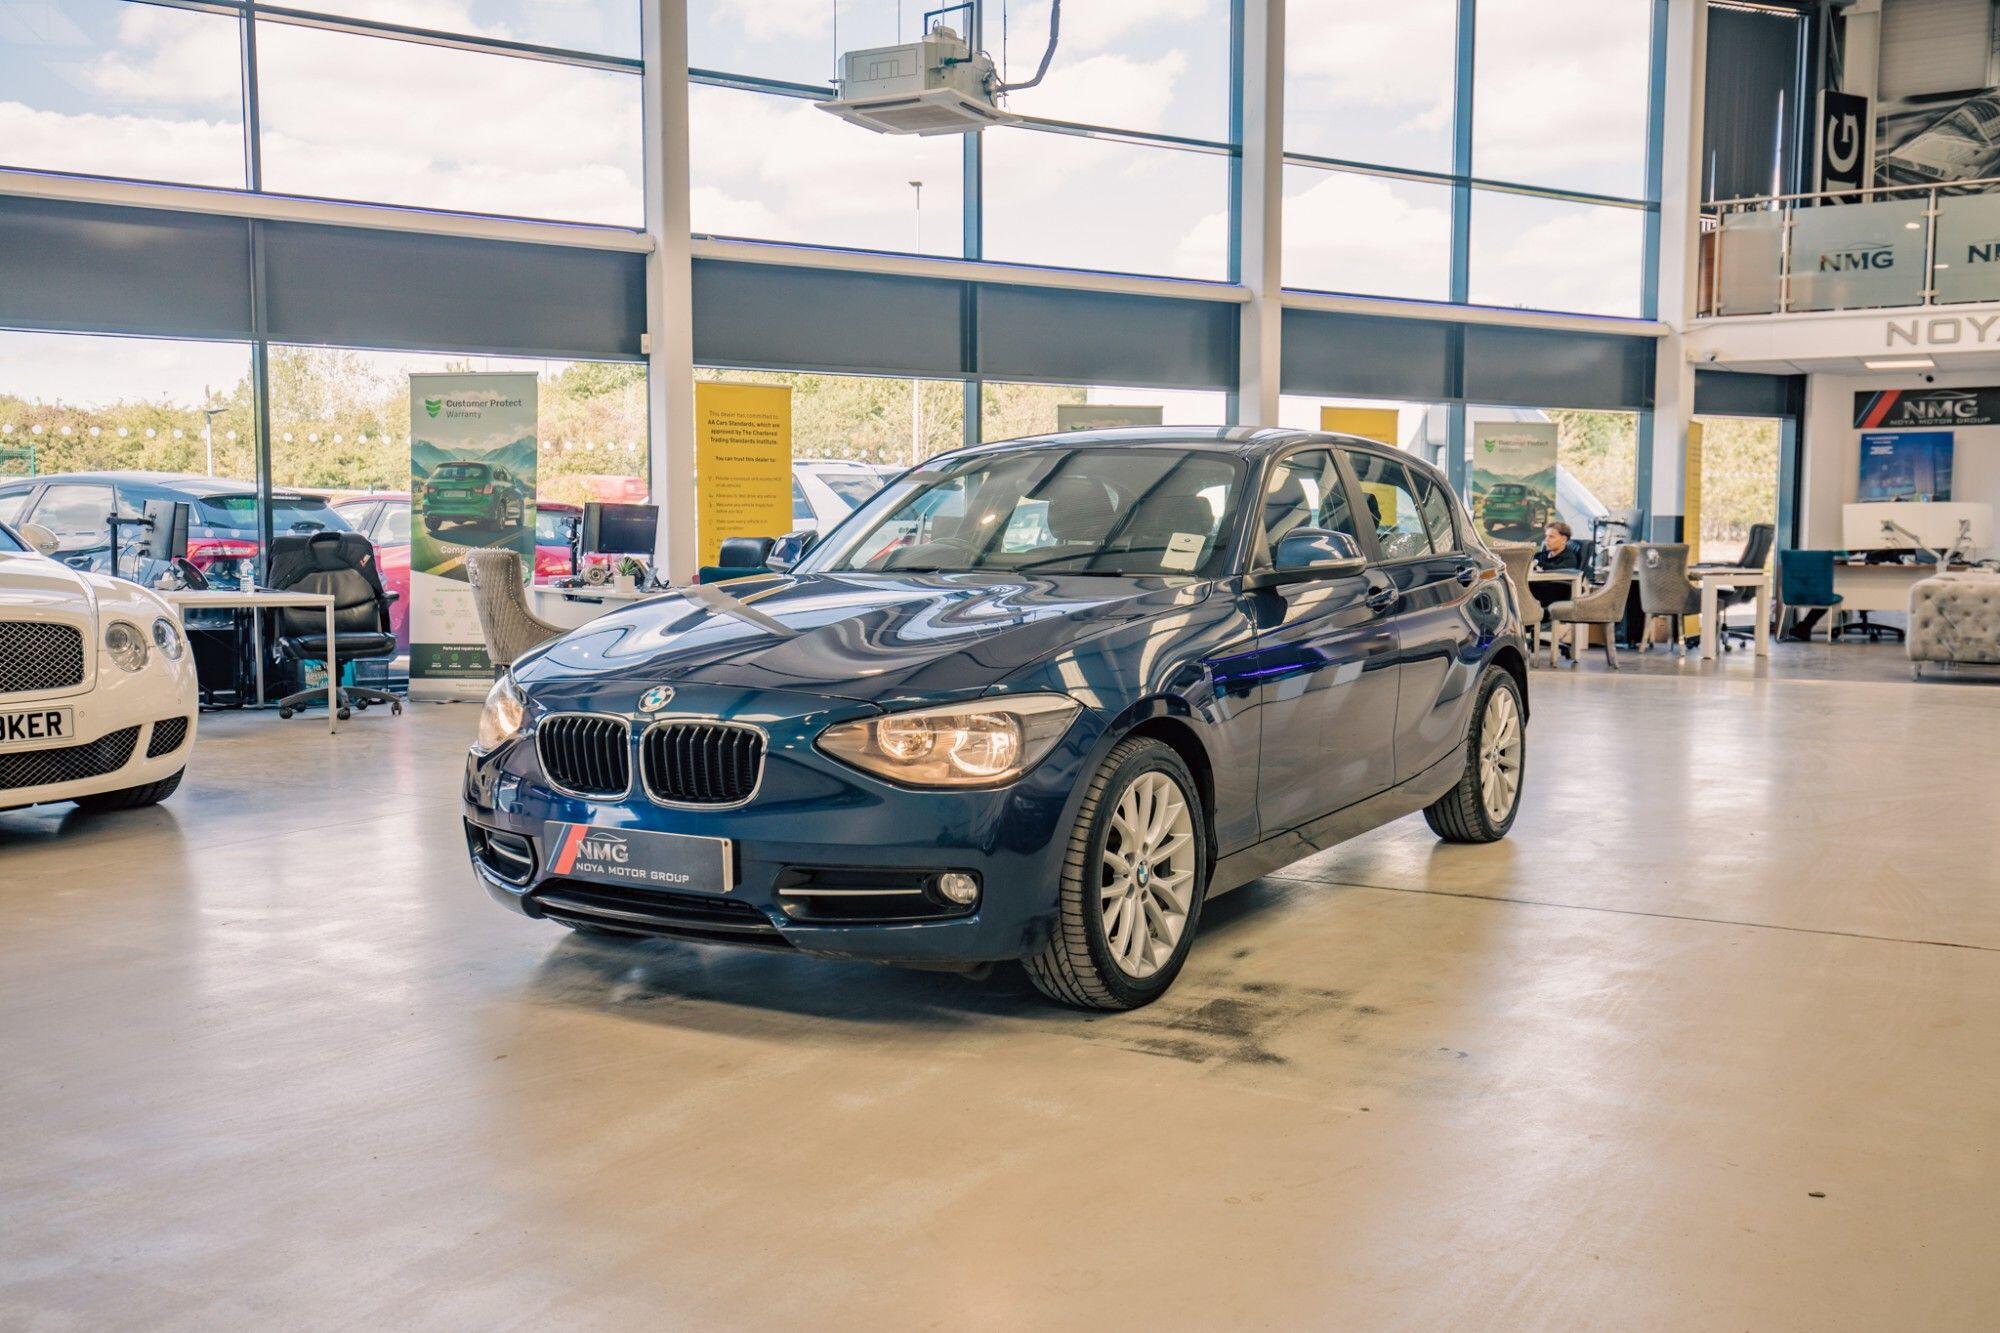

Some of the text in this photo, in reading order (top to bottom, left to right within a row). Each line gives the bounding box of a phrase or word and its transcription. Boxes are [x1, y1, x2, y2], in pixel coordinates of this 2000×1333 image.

[1820, 250, 1894, 272] NMG
[1886, 315, 2000, 347] NOY
[446, 399, 522, 408] Customer Protect
[1903, 399, 1978, 419] NMG
[446, 410, 482, 419] Warranty
[576, 839, 629, 863] NMG
[576, 862, 690, 883] NOYA MOTOR GROUP
